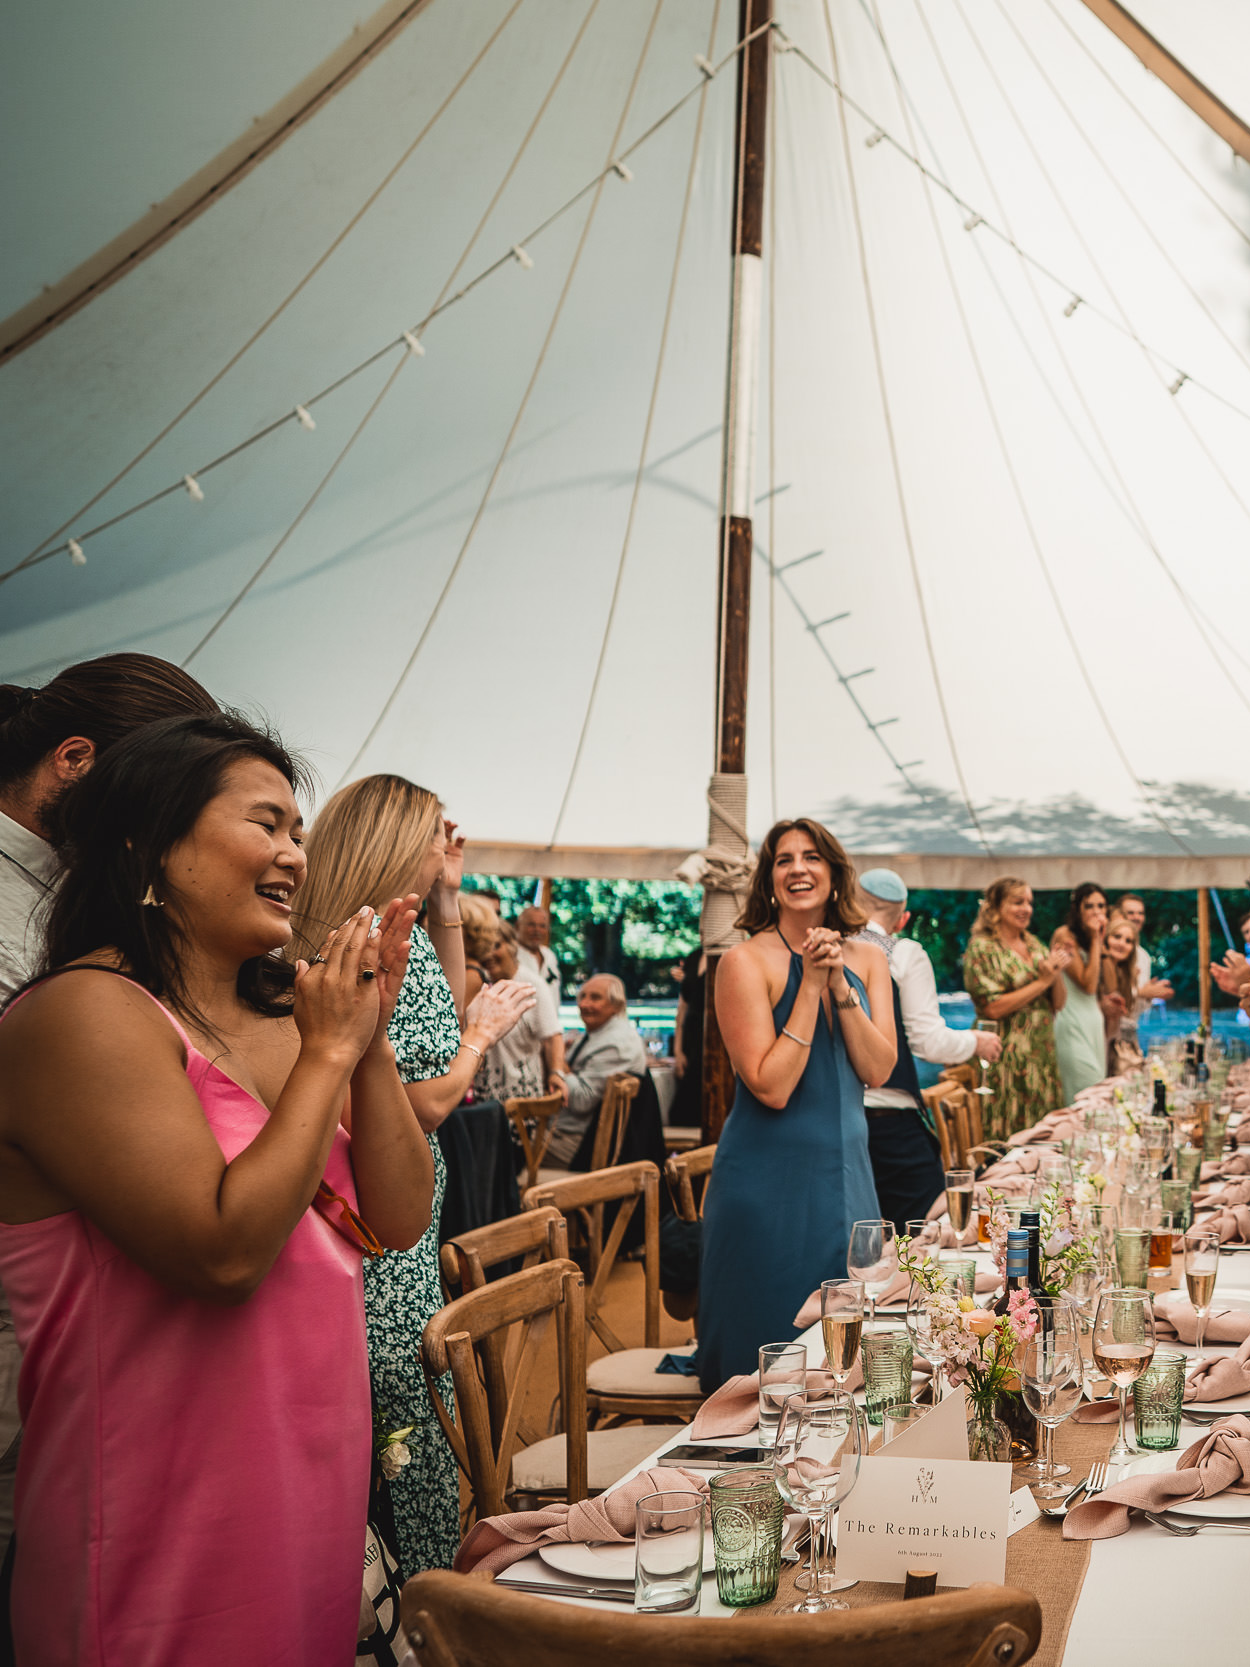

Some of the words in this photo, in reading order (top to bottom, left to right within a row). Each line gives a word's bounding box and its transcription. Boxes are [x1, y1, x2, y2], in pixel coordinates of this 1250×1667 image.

[911, 1495, 918, 1503] H
[930, 1495, 938, 1504] M
[845, 1519, 876, 1534] The
[885, 1522, 997, 1540] Remarkables
